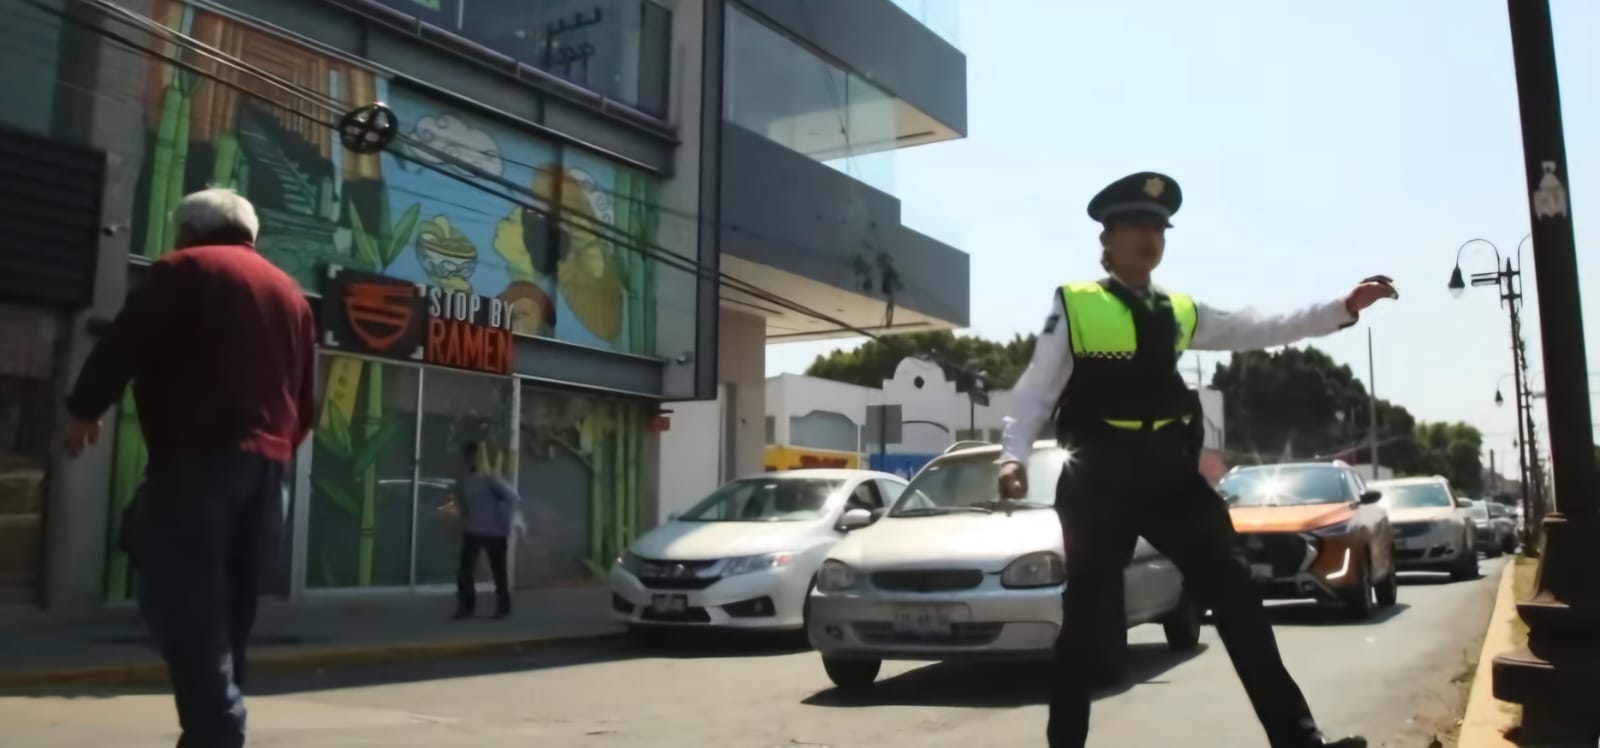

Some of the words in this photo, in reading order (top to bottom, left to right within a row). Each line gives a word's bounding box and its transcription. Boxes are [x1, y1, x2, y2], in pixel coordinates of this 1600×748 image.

[429, 287, 481, 324] STOP
[490, 298, 514, 330] BY
[428, 317, 513, 374] RAMEN
